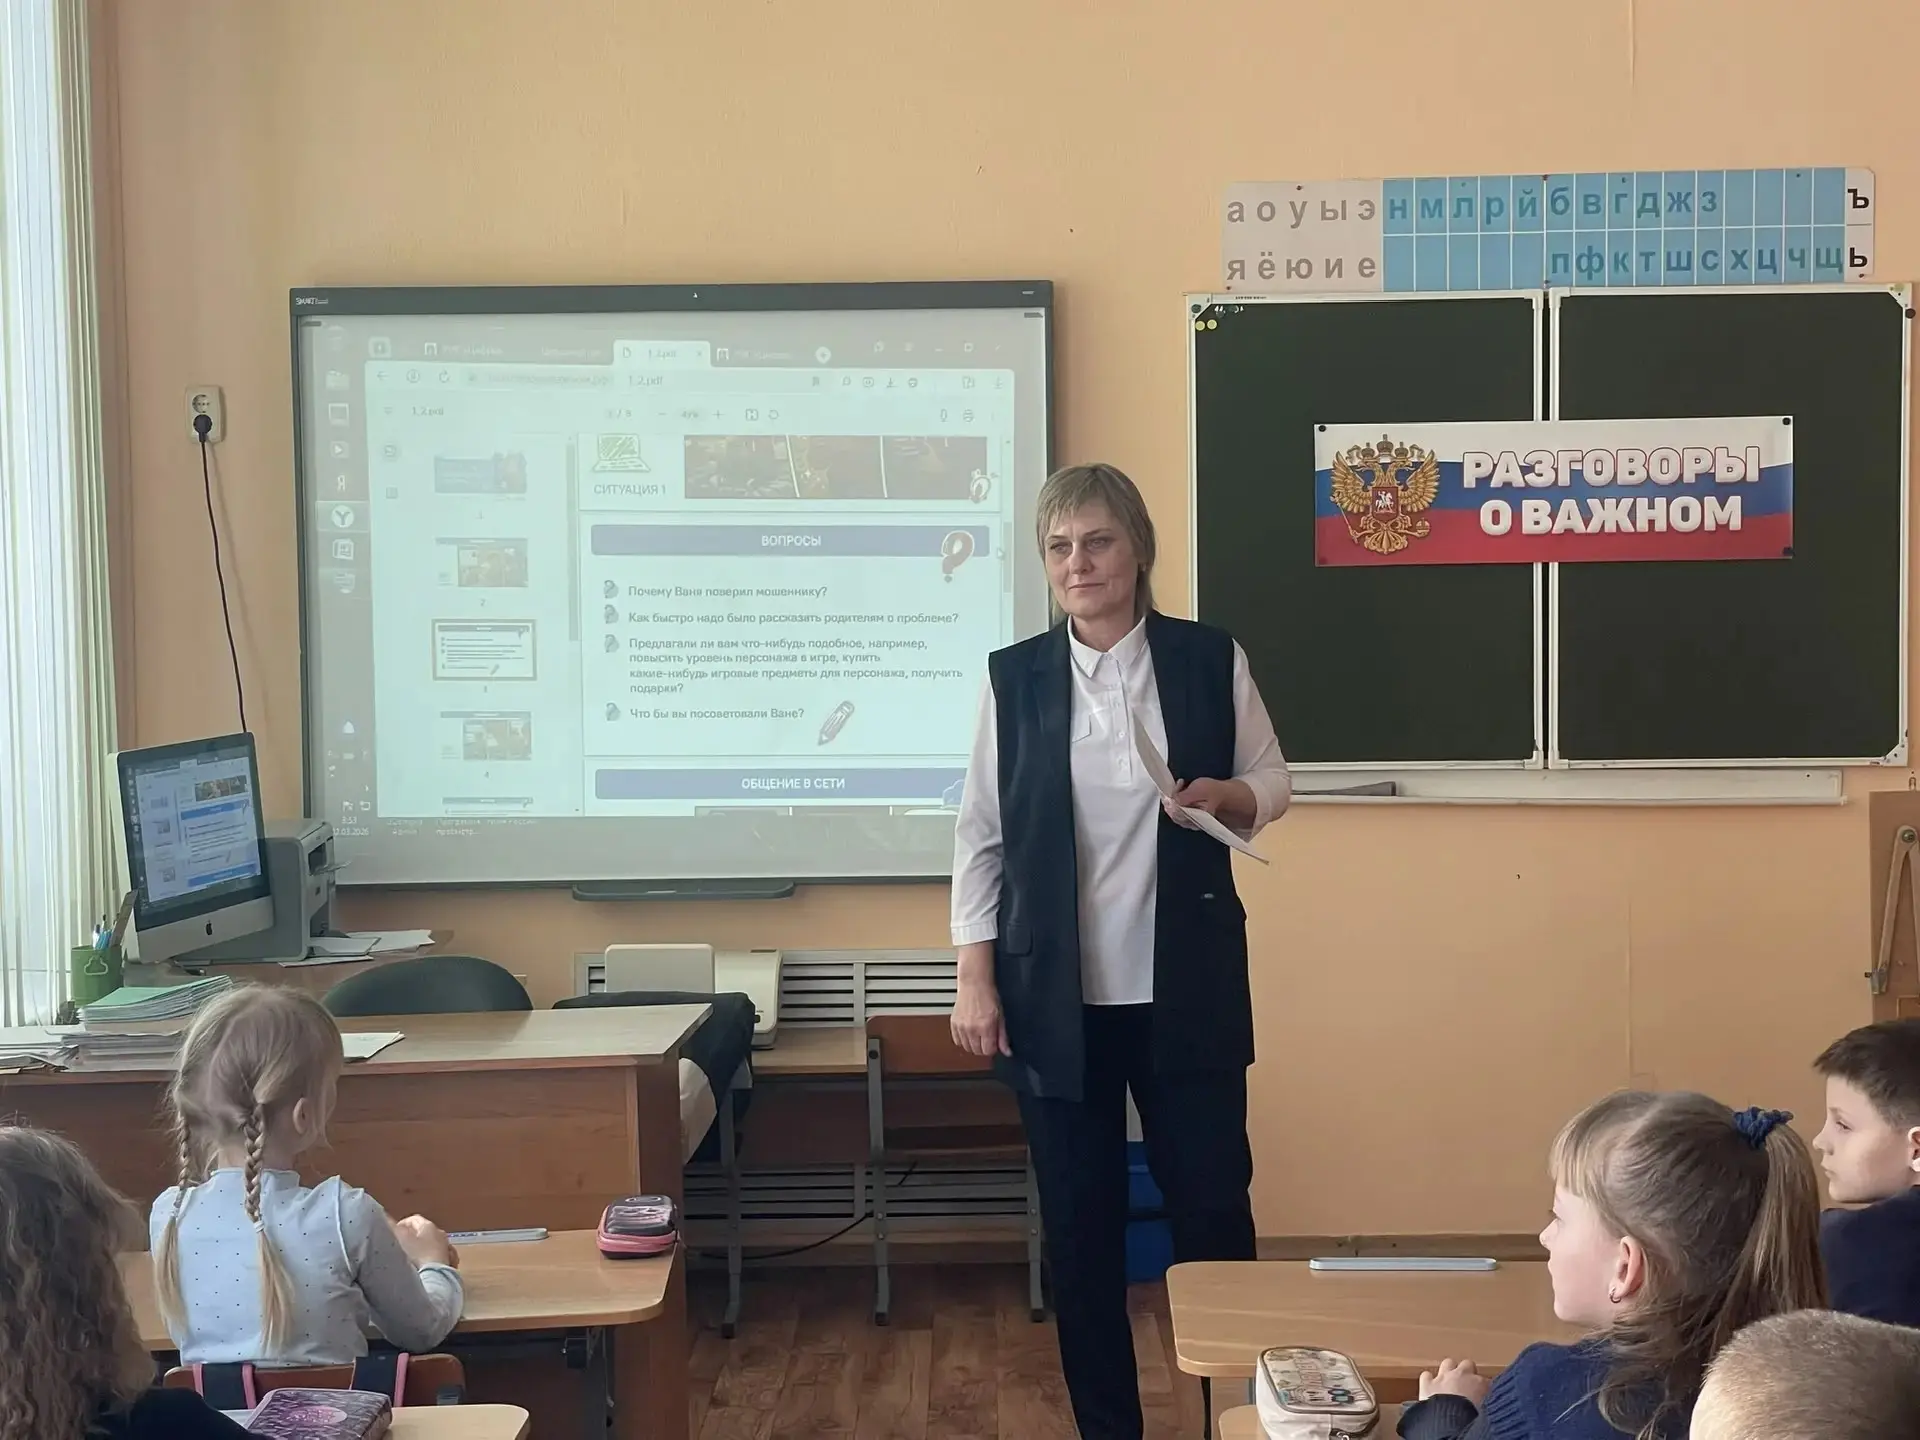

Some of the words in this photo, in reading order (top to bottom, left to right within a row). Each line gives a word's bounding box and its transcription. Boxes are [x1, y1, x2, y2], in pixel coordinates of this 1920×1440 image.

[1462, 446, 1760, 488] РАЗГОВОРЫ
[593, 484, 659, 497] СИТУАЦИЯ
[1480, 499, 1512, 536] О
[1522, 495, 1742, 535] ВАЖНОМ
[761, 535, 822, 547] ВОПРОСЫ
[628, 586, 673, 598] Почему
[674, 586, 703, 597] Ваня
[705, 588, 754, 599] поверил
[755, 586, 828, 599] мошеннику?
[628, 612, 650, 623] Как
[652, 612, 694, 625] быстро
[696, 614, 725, 625] надо
[726, 612, 756, 623] было
[758, 614, 822, 625] рассказать
[824, 614, 885, 625] родителям
[887, 614, 894, 623] о
[896, 612, 960, 625] проблеме?
[629, 638, 697, 650] Предлагали
[699, 640, 715, 649] ли
[717, 640, 739, 649] вам
[741, 638, 806, 651] что-нибудь
[808, 638, 865, 650] подобное,
[868, 640, 928, 651] например,
[629, 653, 684, 663] повысить
[686, 654, 733, 665] уровень
[735, 654, 798, 665] персонажа
[800, 654, 808, 662] в
[809, 654, 839, 665] игре,
[842, 654, 881, 665] купить
[629, 666, 709, 679] какие-нибудь
[710, 667, 759, 679] игровые
[761, 667, 818, 679] предметы
[819, 667, 841, 679] для
[843, 667, 909, 680] персонажа,
[911, 669, 963, 681] получить
[629, 682, 684, 695] подарки?
[630, 708, 651, 719] Что
[653, 708, 669, 719] бы
[671, 710, 687, 719] вы
[689, 710, 768, 720] посоветовали
[770, 707, 805, 720] Ване?
[741, 778, 801, 791] ОБЩЕНИЕ
[803, 778, 811, 789] В
[813, 778, 845, 789] СЕТИ
